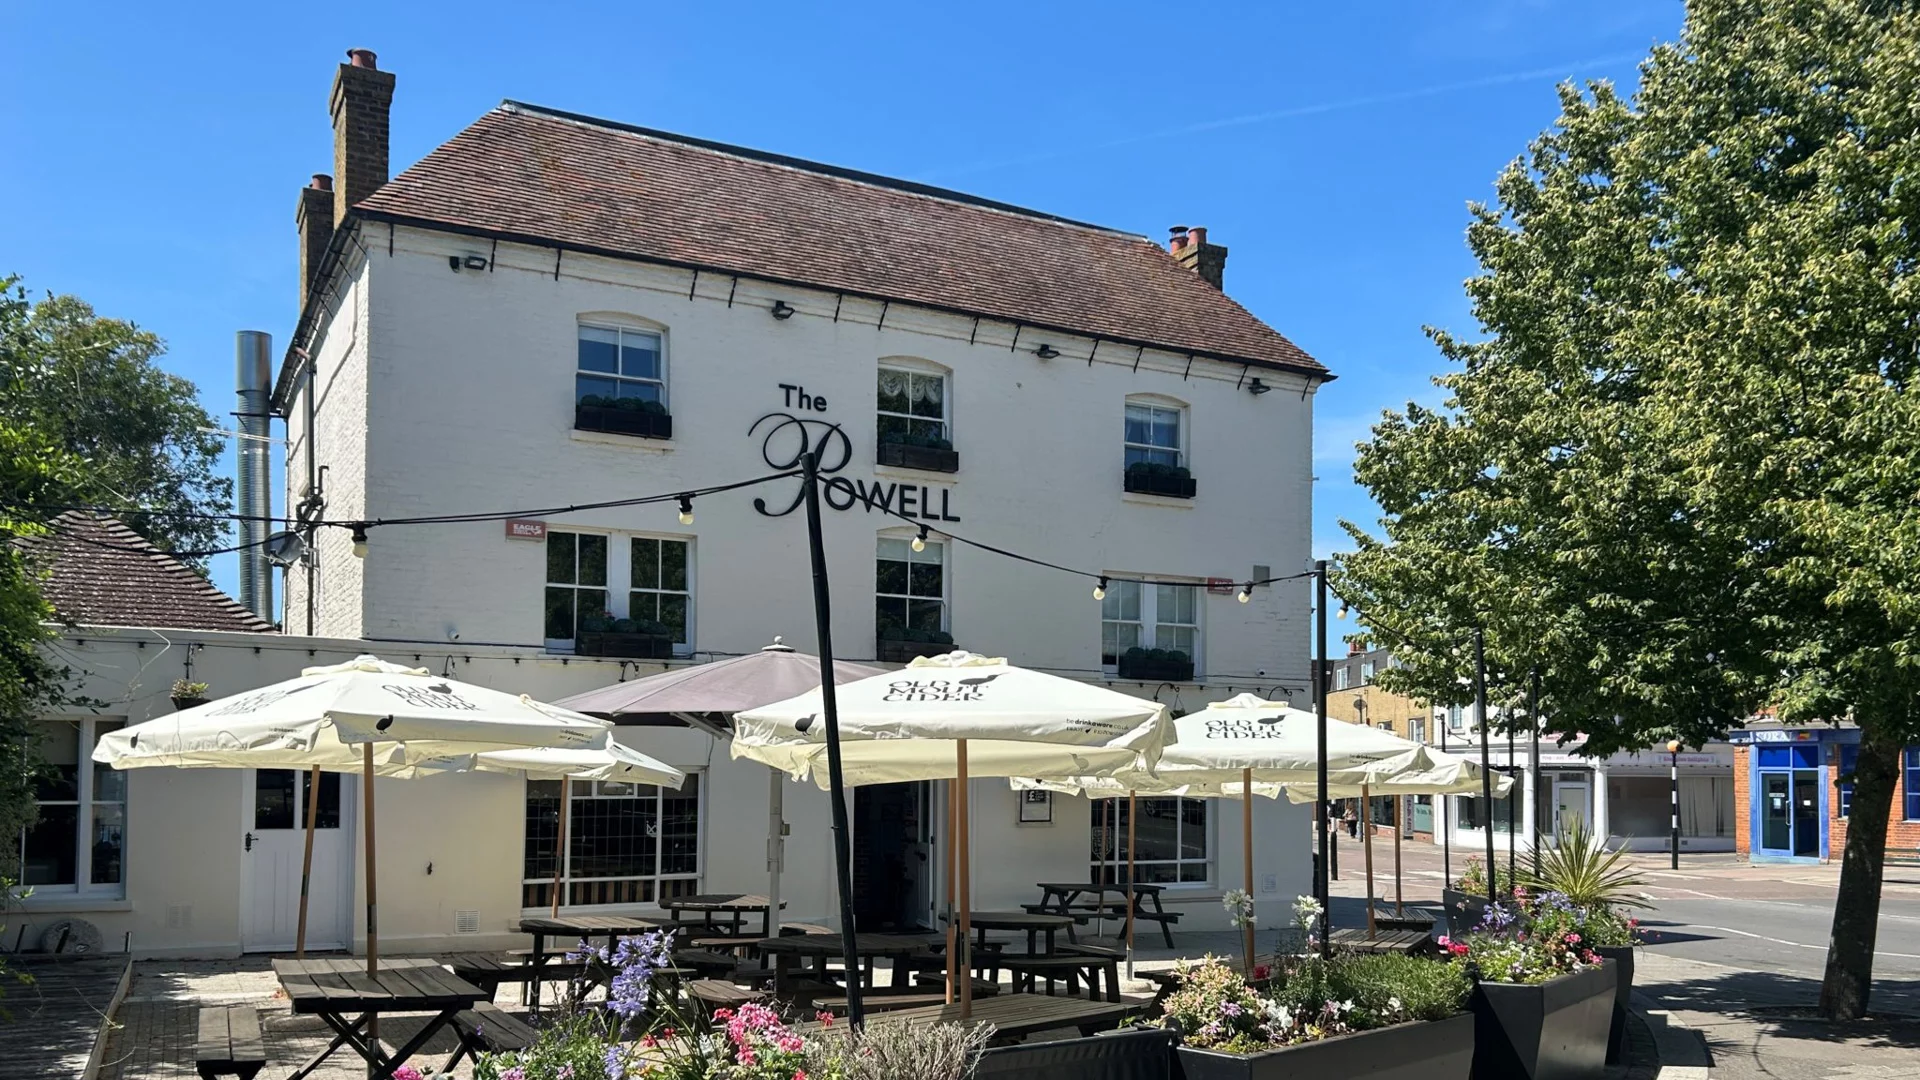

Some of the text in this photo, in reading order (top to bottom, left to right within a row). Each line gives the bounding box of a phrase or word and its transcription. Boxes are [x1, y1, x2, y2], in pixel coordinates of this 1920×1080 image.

[778, 383, 827, 412] The
[382, 684, 429, 699] OLD
[889, 685, 989, 694] MOUT
[883, 693, 984, 701] CIDER
[406, 699, 487, 711] CIDER
[1208, 724, 1284, 732] MOUT
[1206, 731, 1286, 739] CIDER
